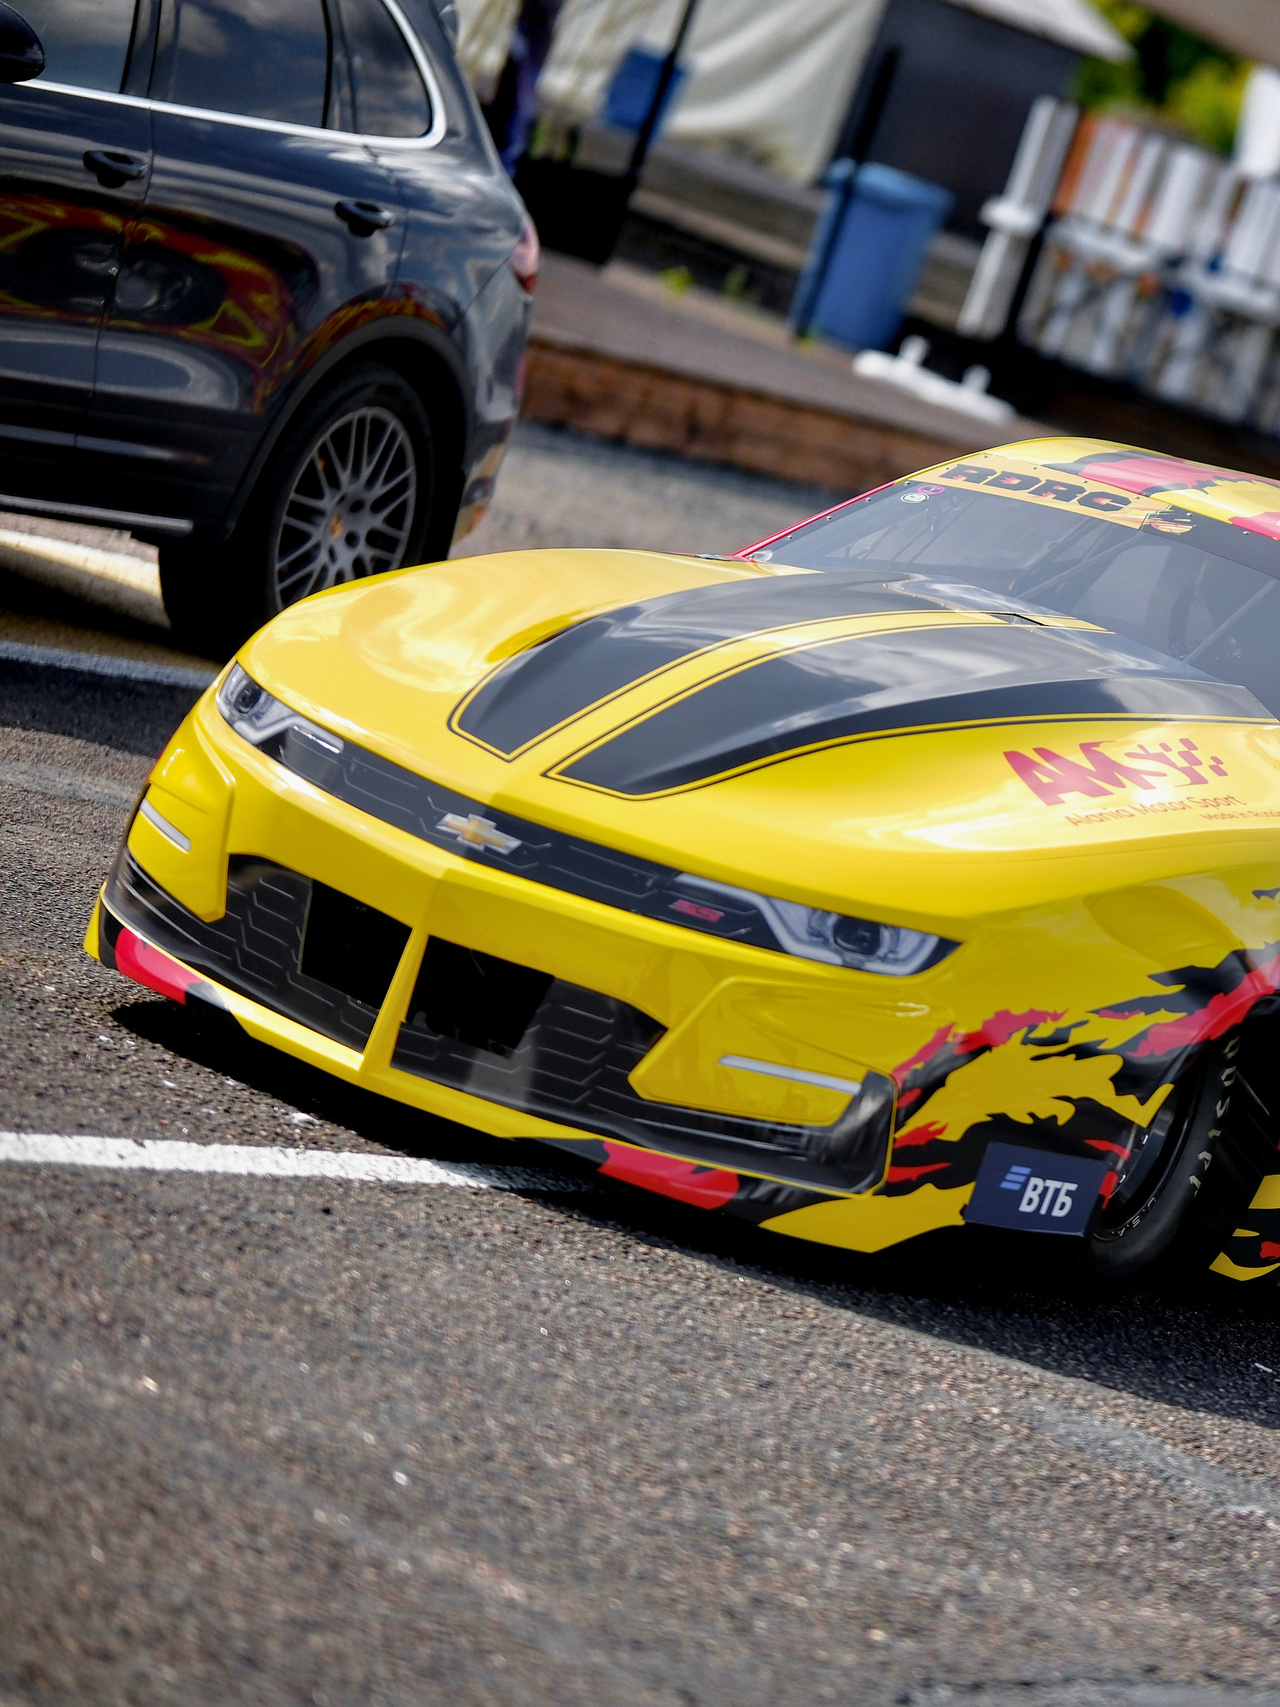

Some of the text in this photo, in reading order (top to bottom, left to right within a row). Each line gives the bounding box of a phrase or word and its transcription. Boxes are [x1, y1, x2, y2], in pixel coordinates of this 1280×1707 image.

[940, 464, 1132, 512] RDRC
[1064, 795, 1248, 827] Alania Motor Sport
[668, 900, 725, 922] SS
[1018, 1176, 1078, 1217] ВТБ
